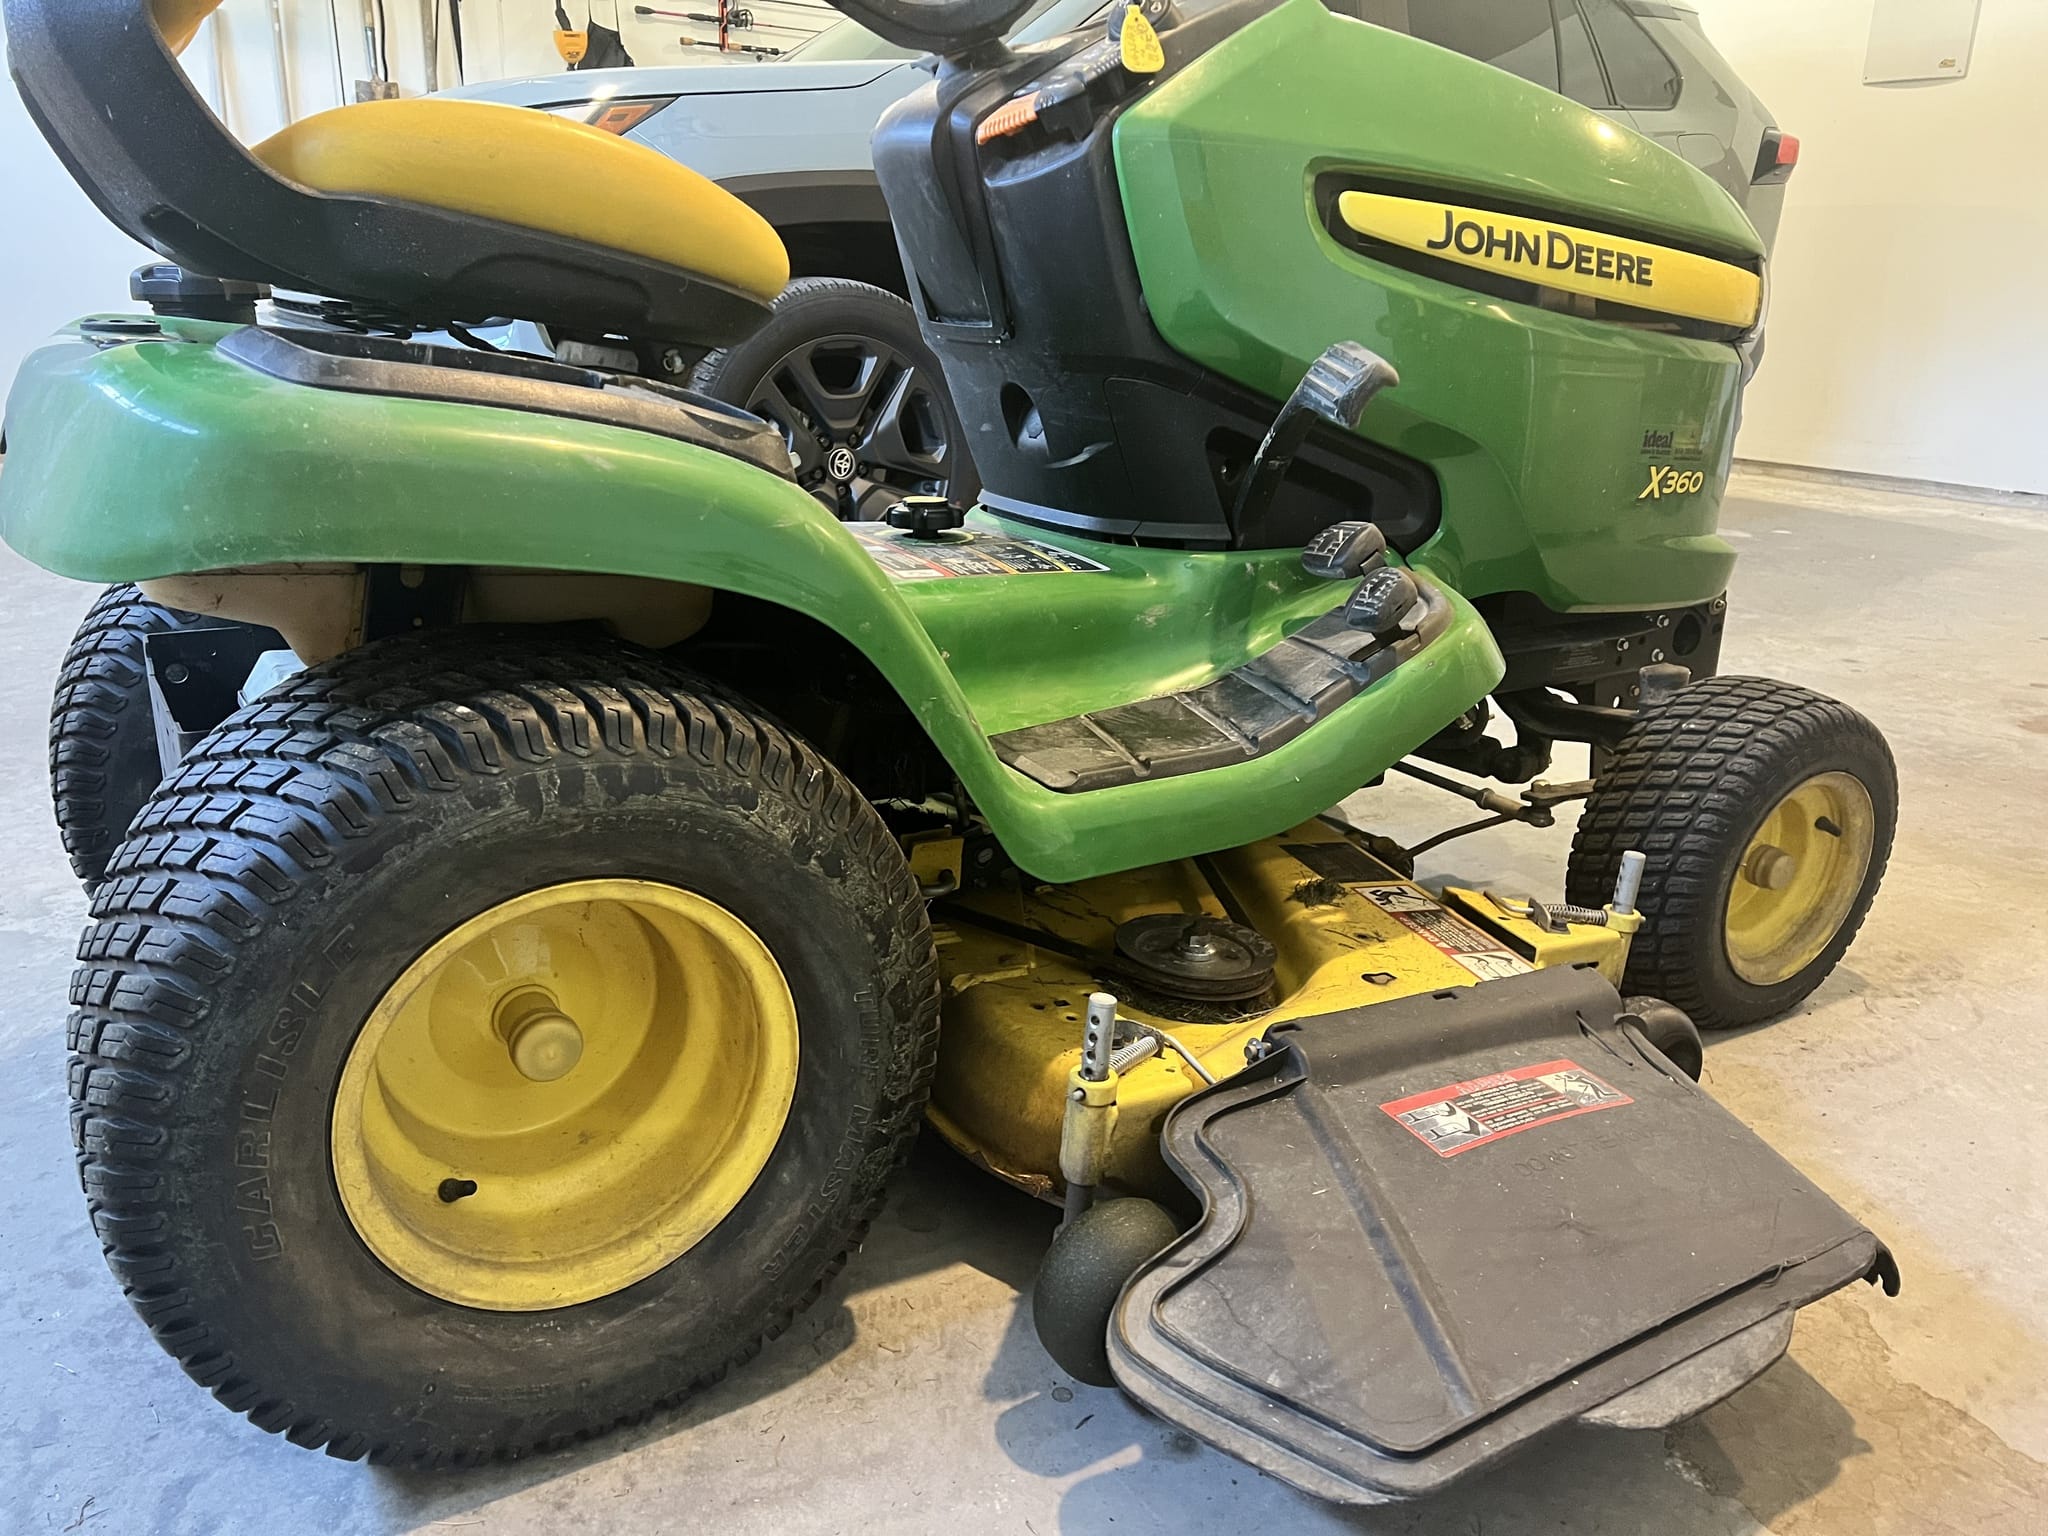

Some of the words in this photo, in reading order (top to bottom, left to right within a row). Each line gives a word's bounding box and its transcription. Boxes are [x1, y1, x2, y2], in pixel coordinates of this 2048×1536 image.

[1426, 210, 1540, 266] JOHN
[1546, 230, 1653, 287] DEERE
[1643, 430, 1674, 448] ideal
[1637, 465, 1704, 499] X360
[236, 924, 357, 1262] CARLISLE
[762, 1104, 873, 1281] MASTER
